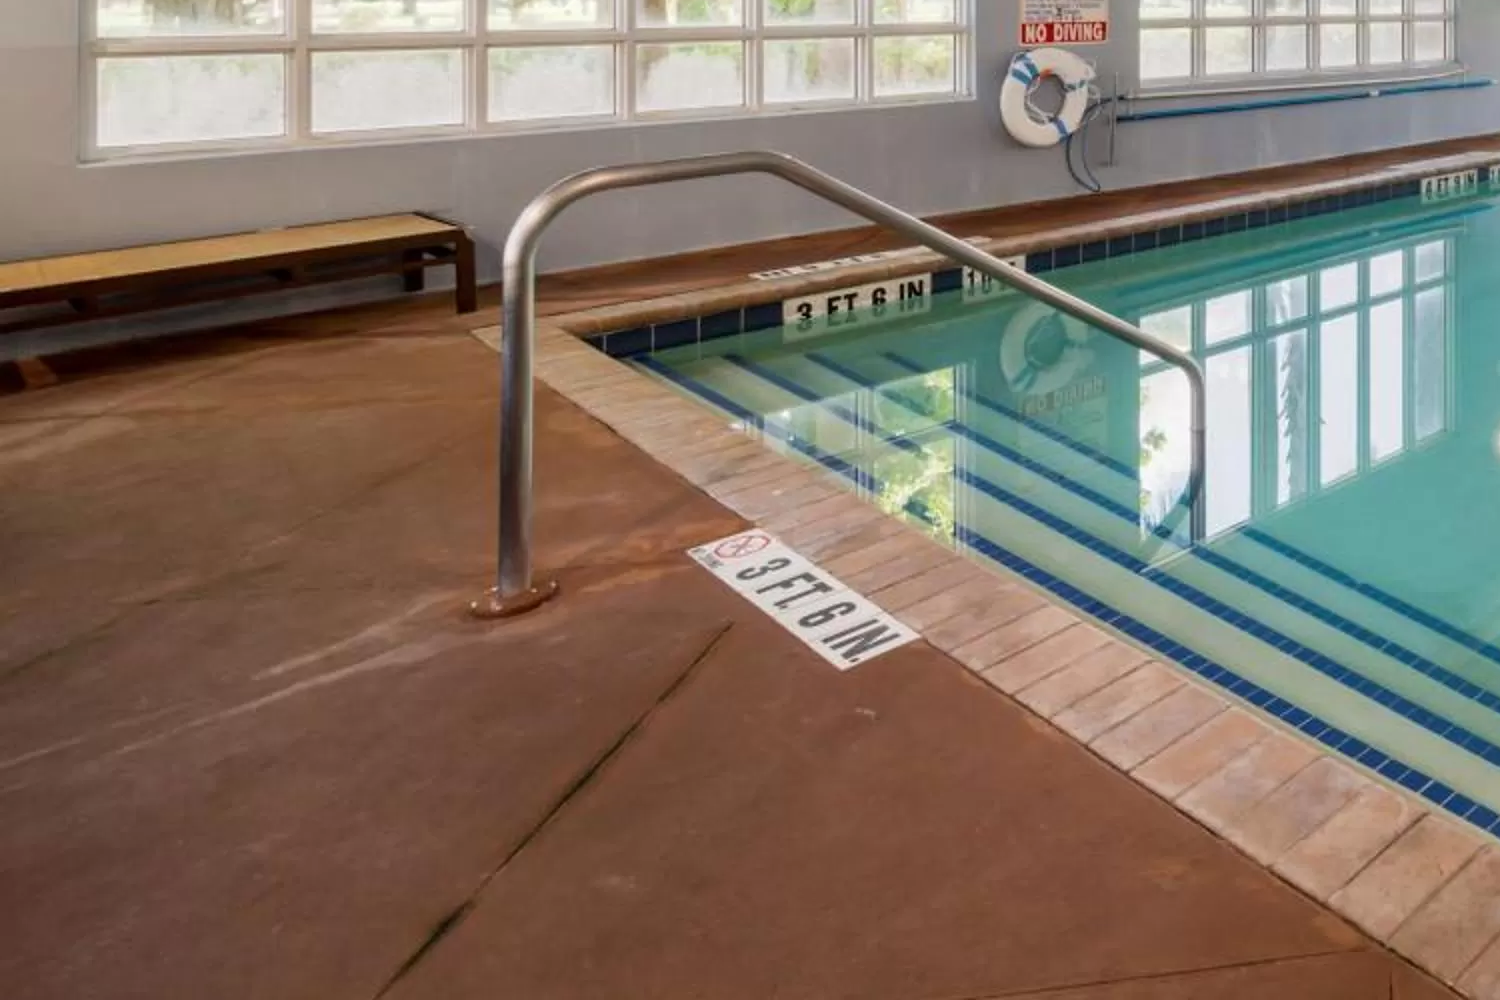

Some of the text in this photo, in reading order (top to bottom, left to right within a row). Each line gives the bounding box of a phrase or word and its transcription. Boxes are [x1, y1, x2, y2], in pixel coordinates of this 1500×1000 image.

[1025, 22, 1103, 42] NO DIVING
[796, 302, 813, 320] 3
[827, 292, 858, 316] FT
[899, 279, 923, 300] IN
[736, 557, 792, 580] 3
[797, 601, 857, 628] 6
